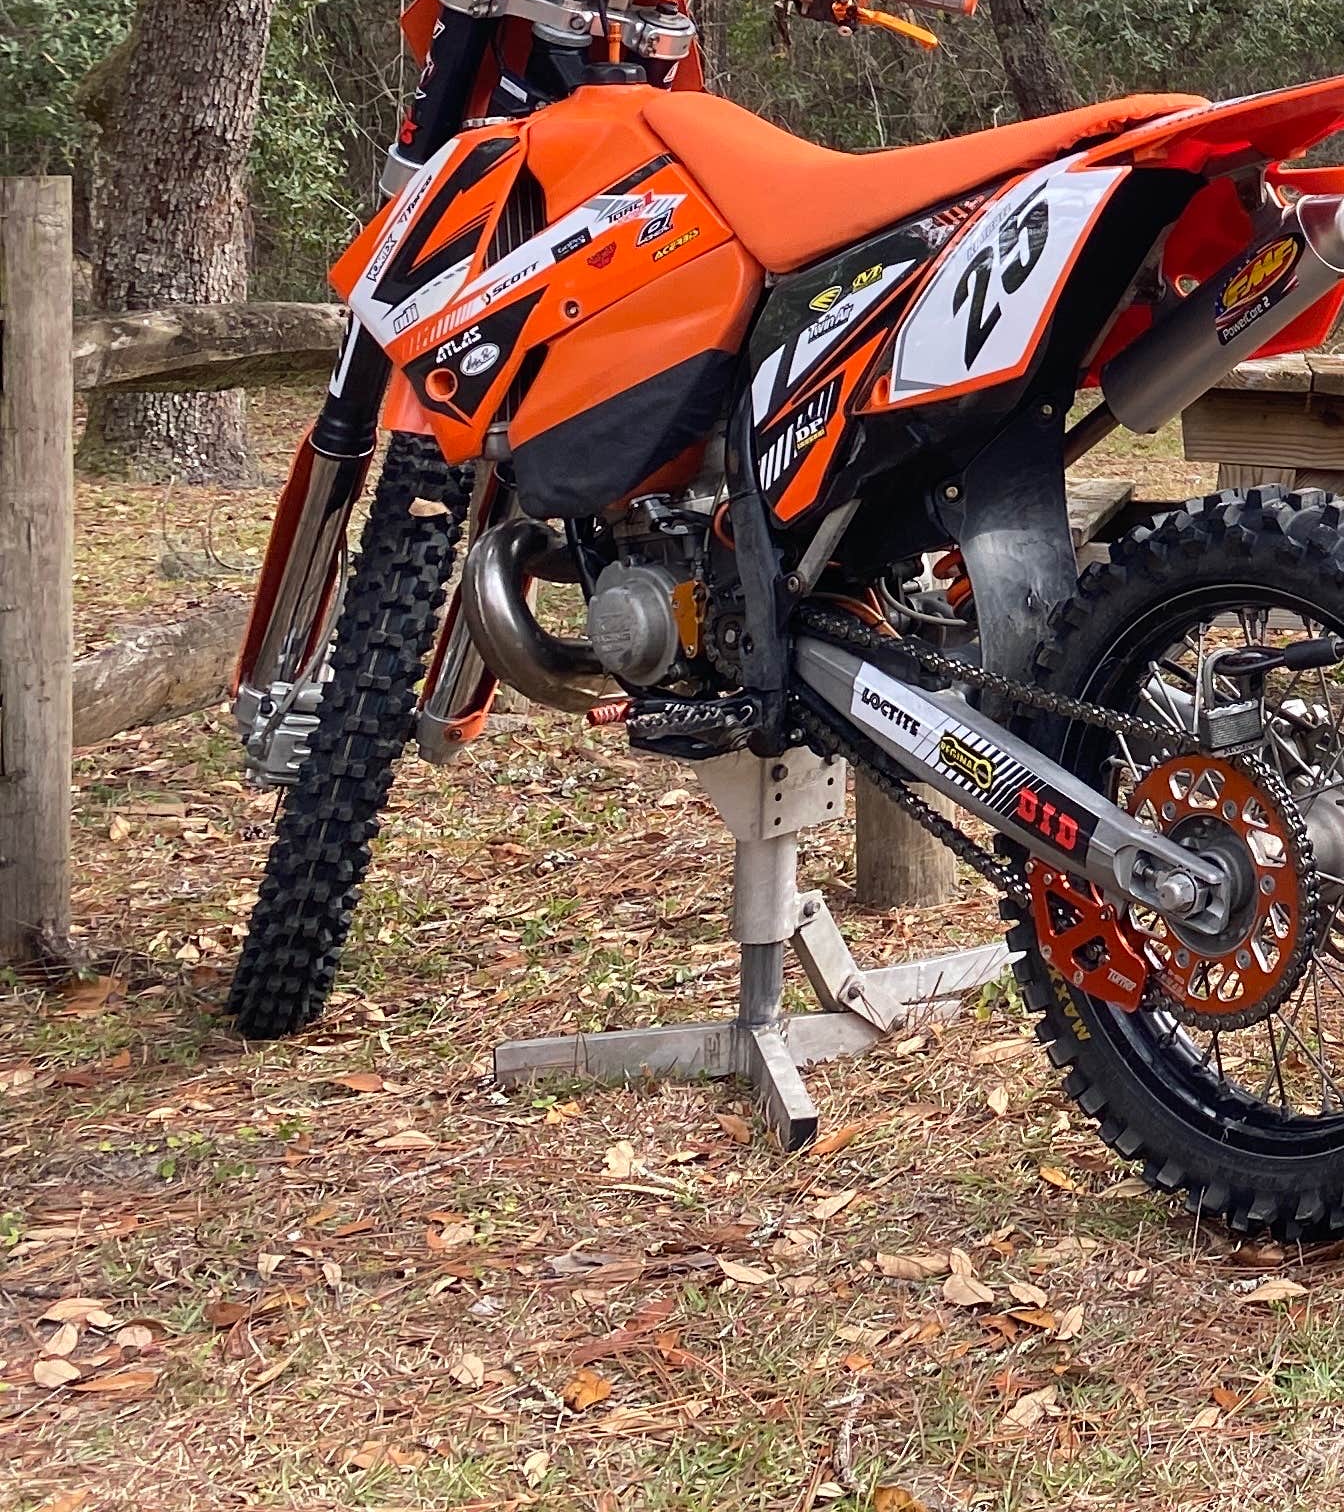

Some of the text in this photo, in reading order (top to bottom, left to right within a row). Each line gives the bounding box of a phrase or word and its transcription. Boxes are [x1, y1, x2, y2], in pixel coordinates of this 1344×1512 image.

[492, 260, 540, 298] SCOTT
[952, 178, 1049, 372] 25
[1224, 237, 1295, 307] FMF
[1222, 296, 1271, 340] PowerCore 2
[435, 326, 482, 364] ATLAS
[795, 417, 824, 442] DP
[861, 687, 921, 737] LOCTITE
[940, 741, 974, 770] REGINA
